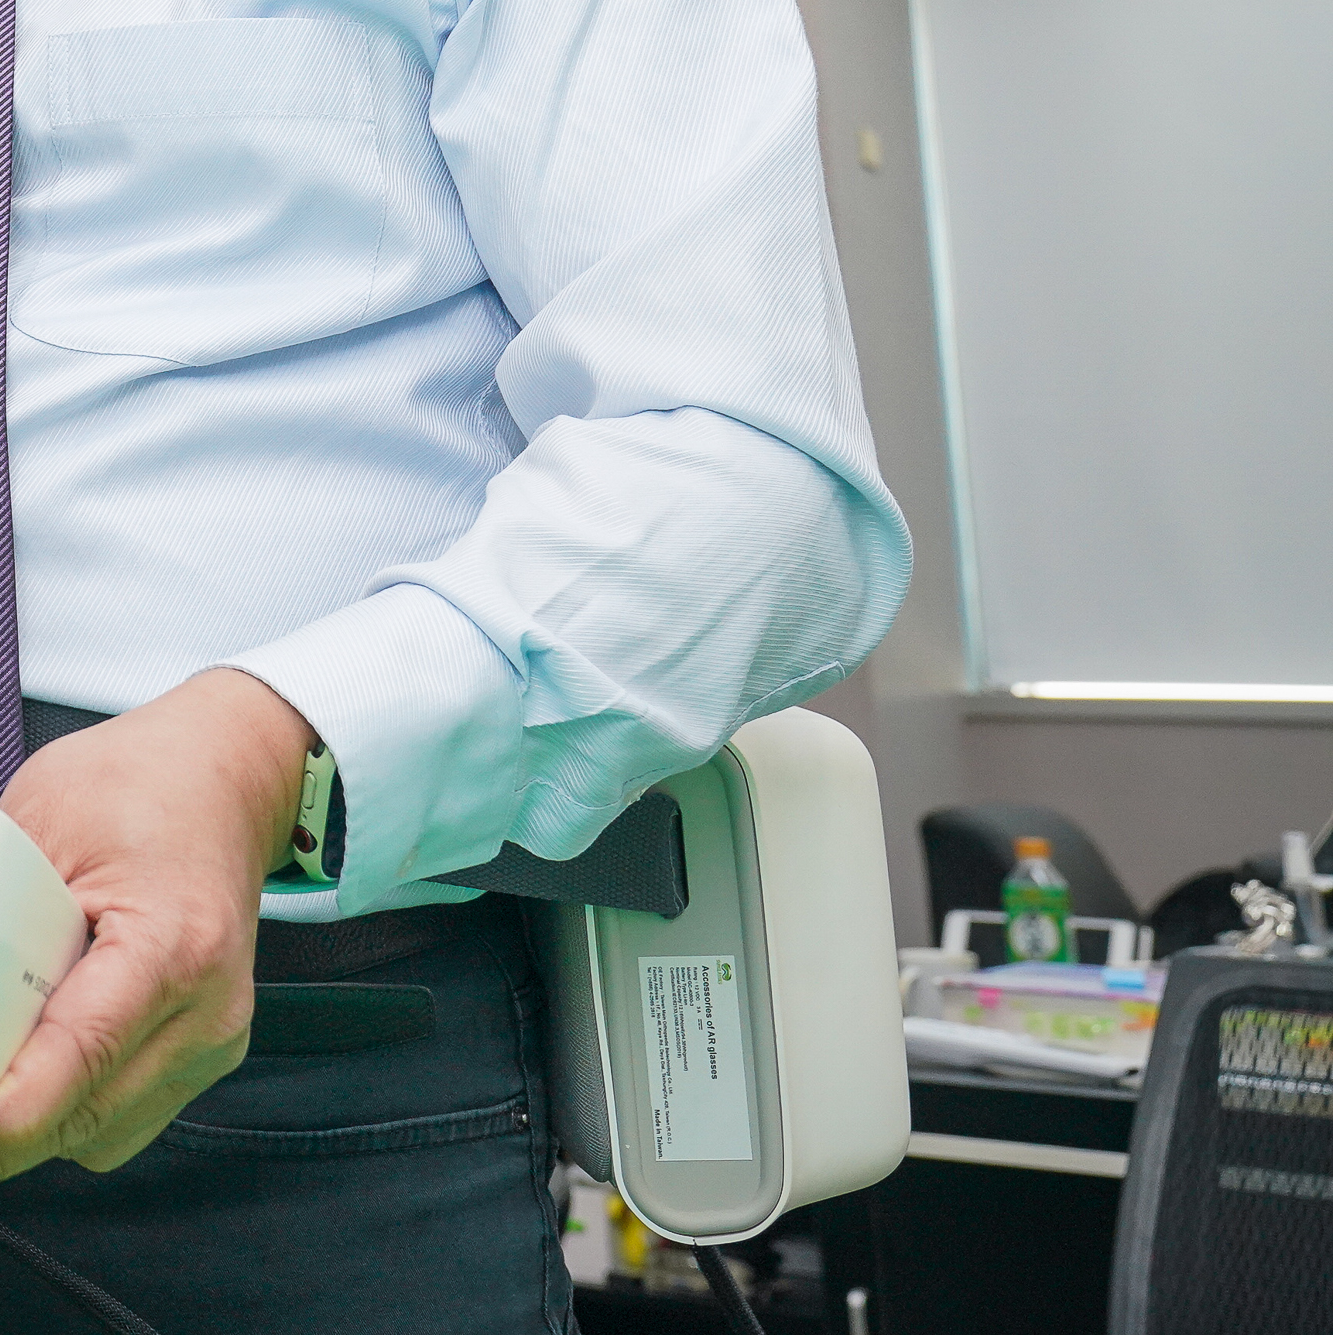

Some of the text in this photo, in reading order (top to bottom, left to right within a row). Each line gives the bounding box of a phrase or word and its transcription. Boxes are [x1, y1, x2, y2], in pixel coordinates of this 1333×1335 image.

[702, 966, 719, 1080] Accessories of AR glasses
[656, 1136, 664, 1159] Taiwan.
